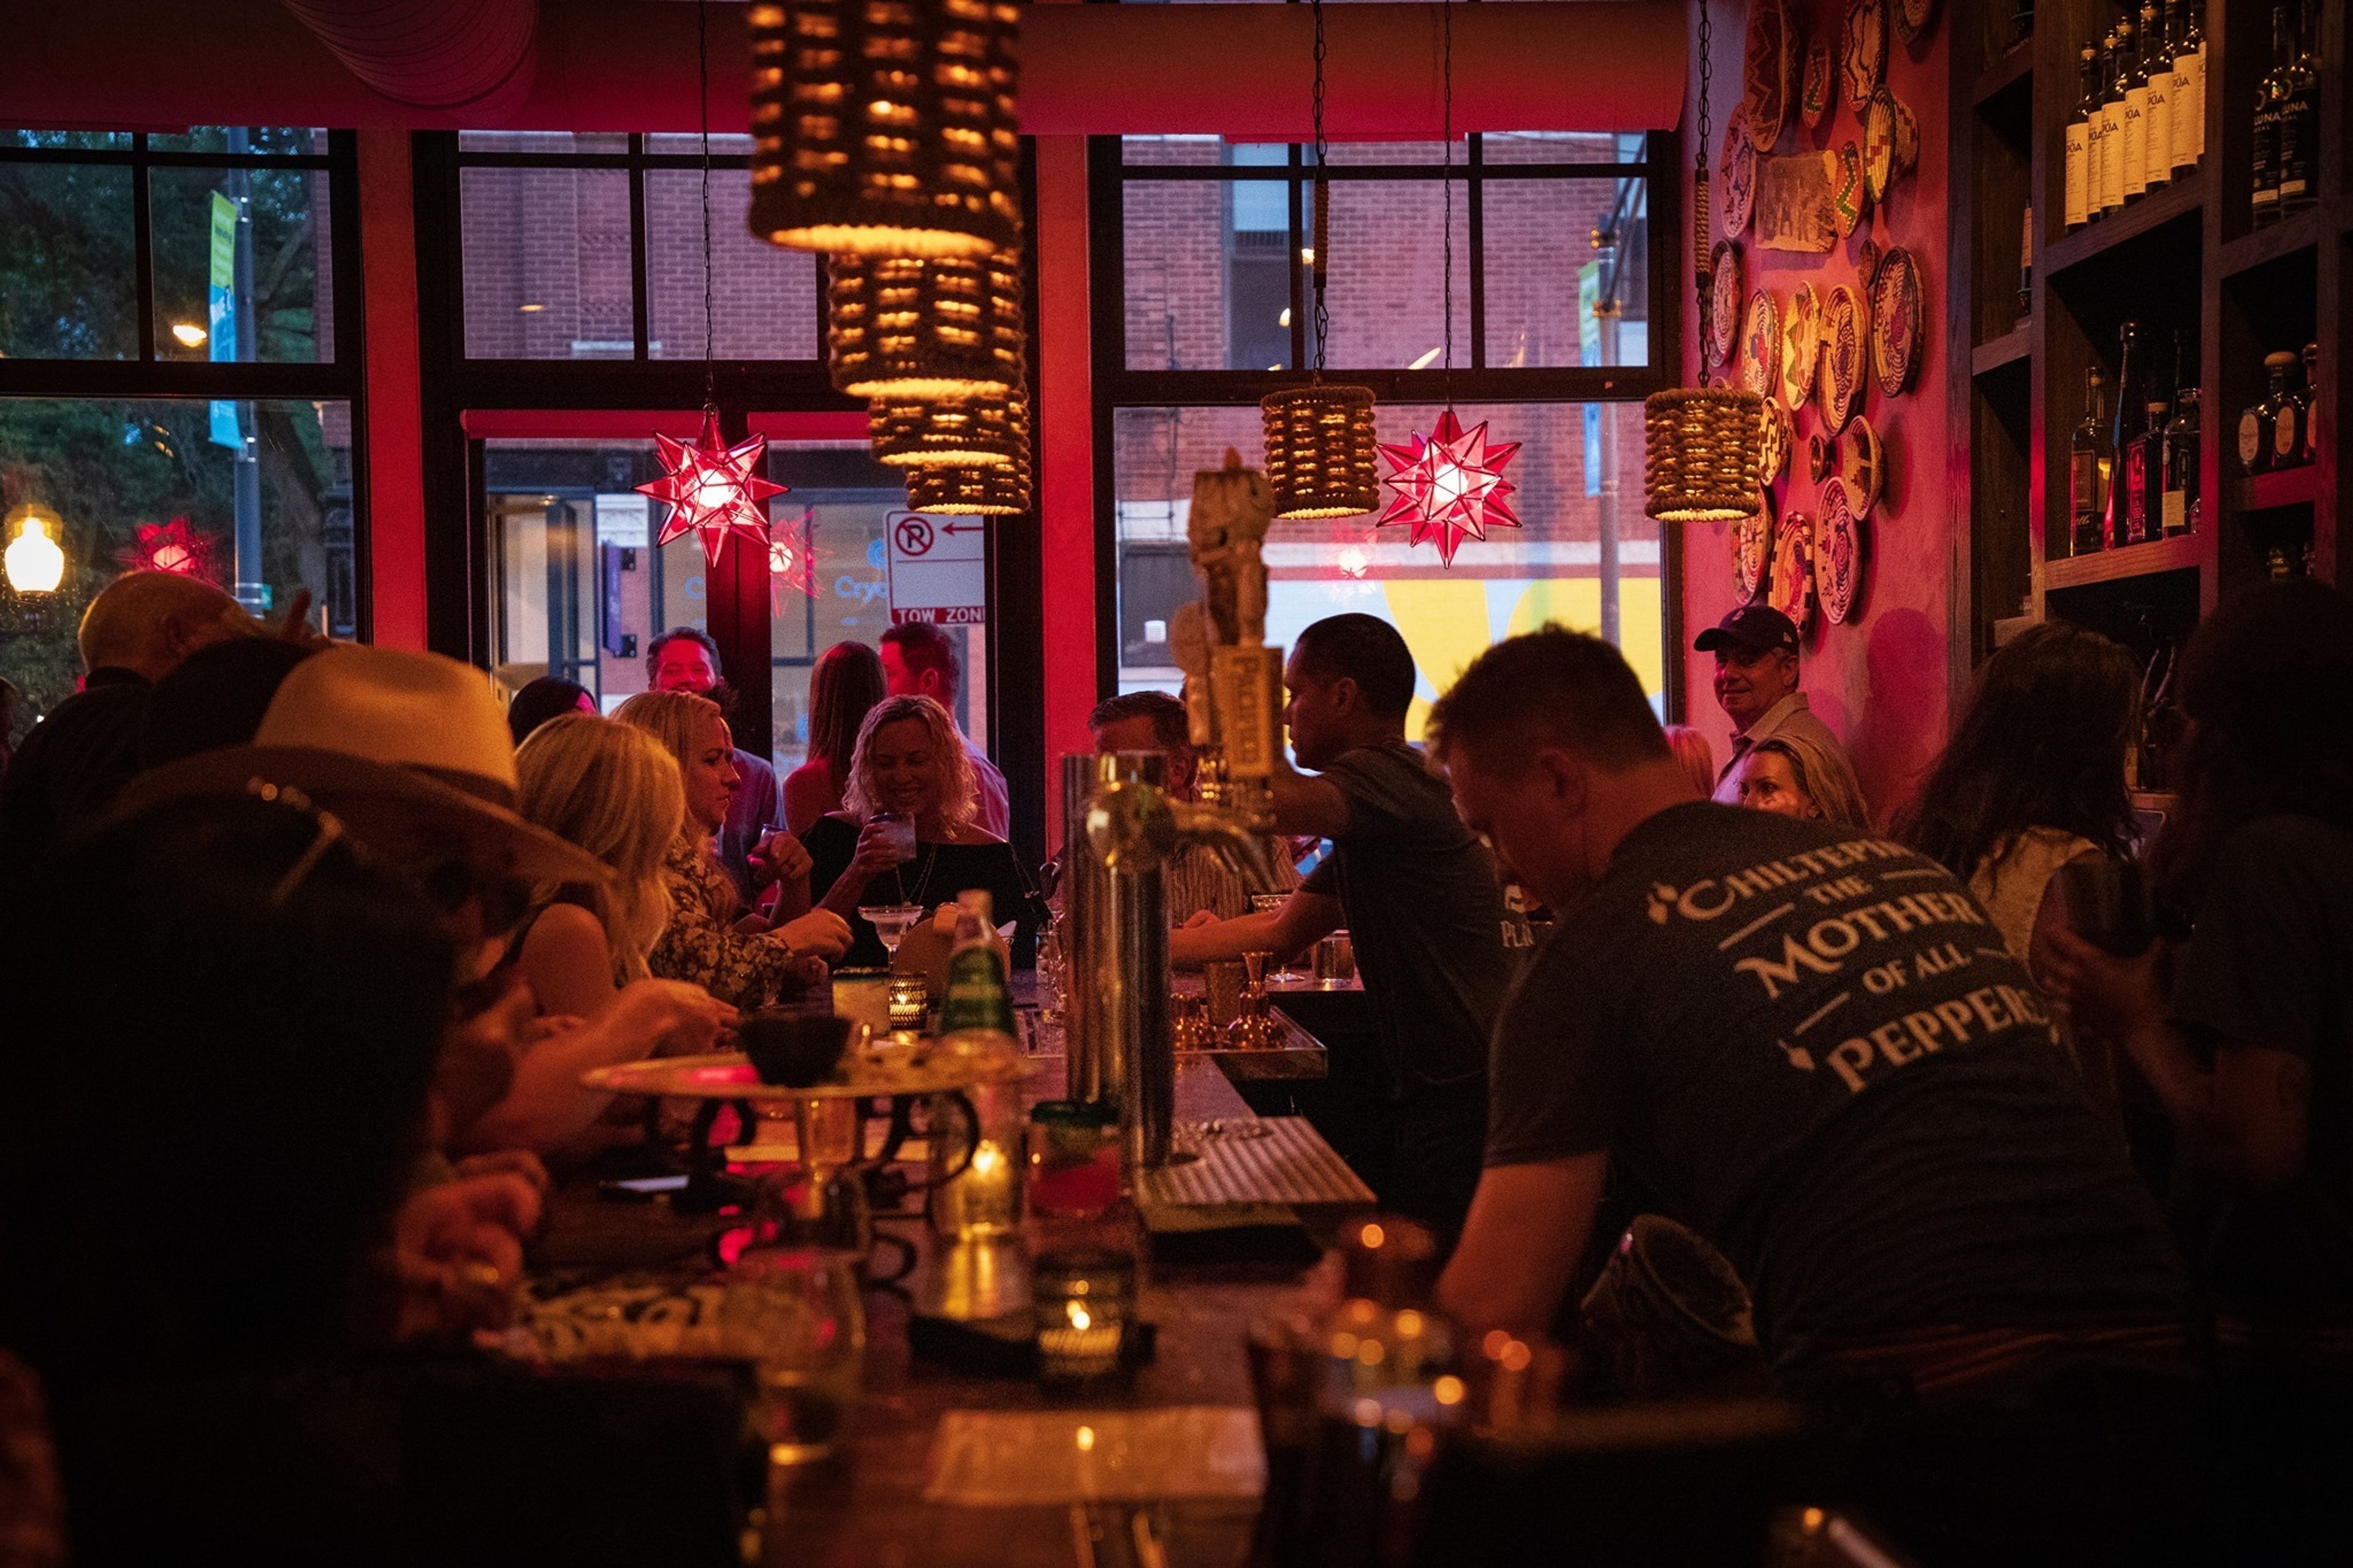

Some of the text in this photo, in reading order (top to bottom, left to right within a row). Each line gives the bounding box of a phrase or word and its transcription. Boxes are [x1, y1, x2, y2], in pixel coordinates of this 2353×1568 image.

[898, 608, 936, 624] TOW
[1803, 874, 1873, 906] THE
[1733, 891, 1985, 1000] MOTHER
[1861, 942, 1973, 996] OF ALL
